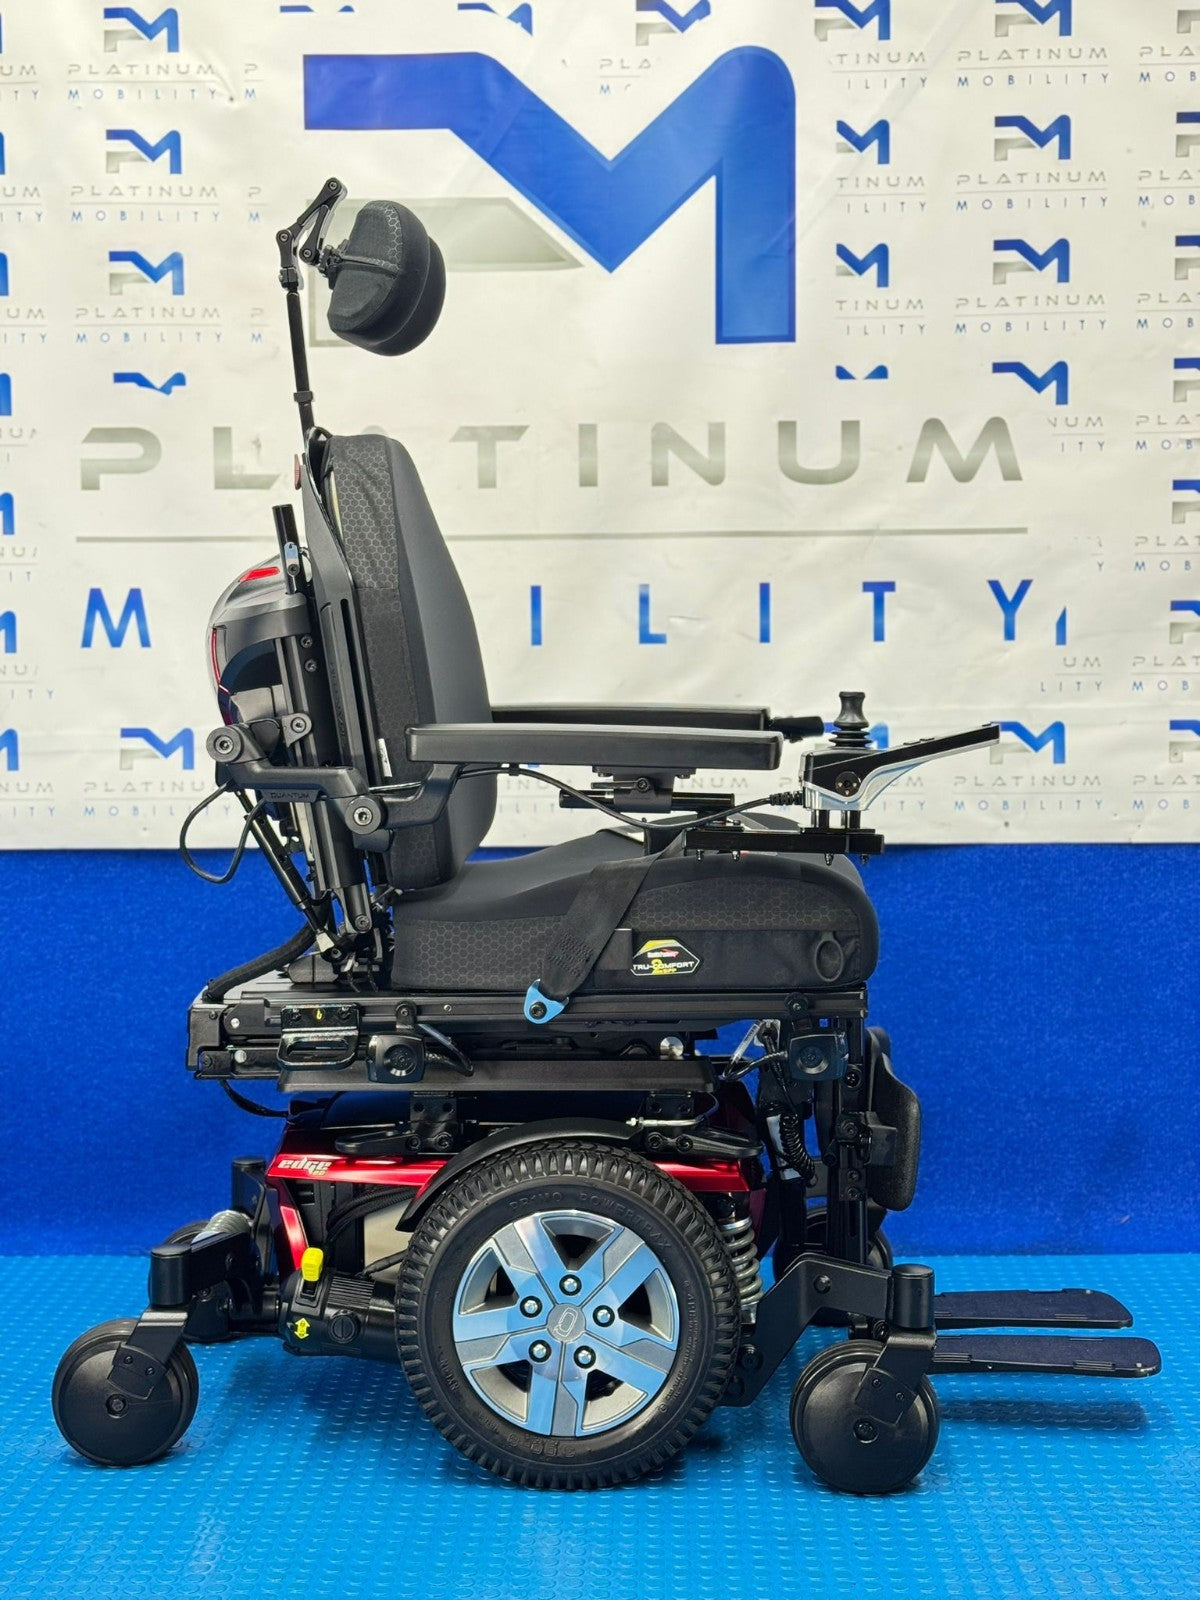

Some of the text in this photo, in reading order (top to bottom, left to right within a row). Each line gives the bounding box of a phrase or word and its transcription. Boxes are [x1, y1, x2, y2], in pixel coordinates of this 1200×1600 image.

[829, 52, 926, 65] TINUM
[956, 48, 1107, 62] PLATINUM
[68, 63, 217, 76] PLATINUM
[957, 73, 1109, 87] MOBILITY
[68, 88, 217, 100] MOBILITY
[956, 171, 1106, 185] PLATINUM
[71, 186, 218, 197] PLATINUM
[956, 197, 1108, 211] MOBILITY
[72, 211, 220, 222] MOBILITY
[955, 294, 1105, 310] PLATINUM
[75, 306, 221, 319] PLATINUM
[955, 320, 1107, 334] MOBILITY
[76, 331, 223, 343] MOBILITY
[81, 416, 1023, 490] PLTINUM
[81, 579, 1034, 648] MILITY
[83, 781, 214, 793] PLATINU
[954, 774, 1102, 787] PLATINUM
[954, 800, 1102, 811] MOBILITY
